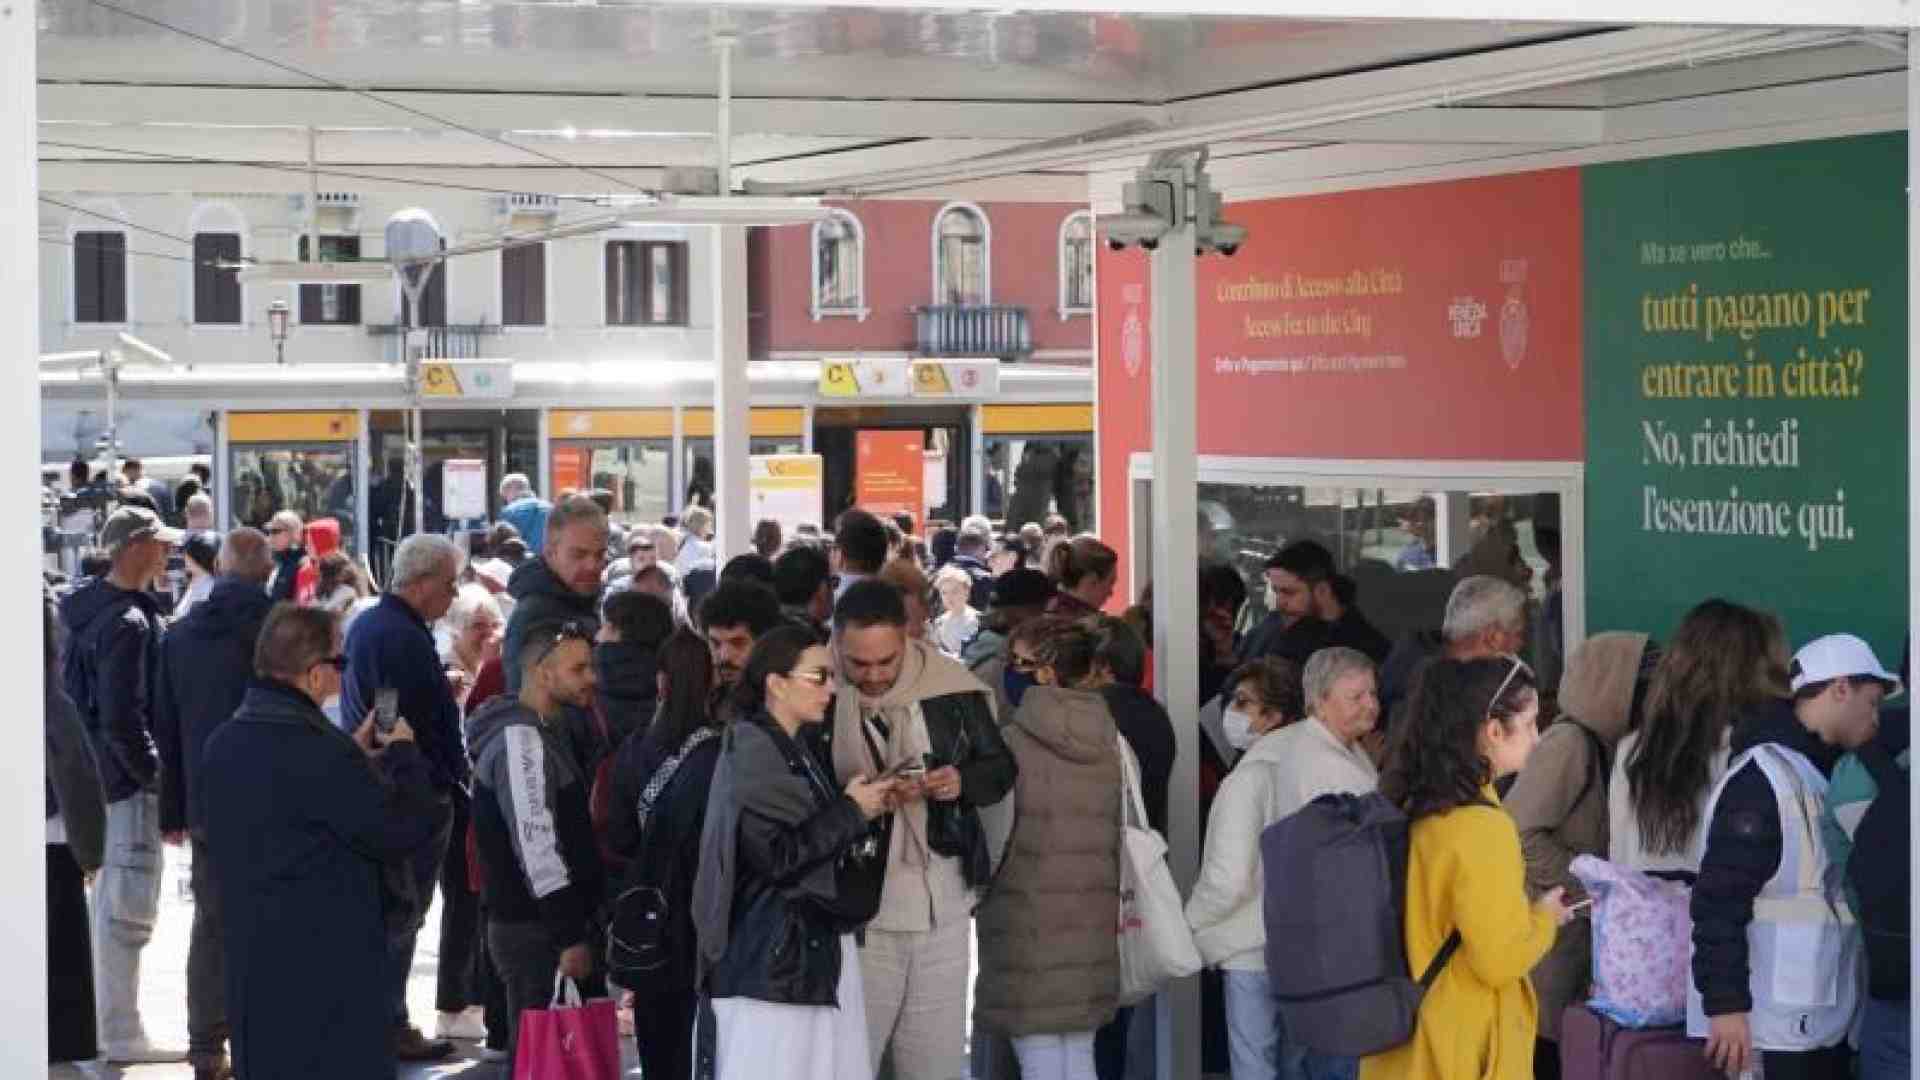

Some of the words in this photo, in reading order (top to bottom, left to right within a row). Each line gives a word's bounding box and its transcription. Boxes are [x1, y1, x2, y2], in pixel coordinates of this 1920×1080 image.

[1690, 242, 1726, 262] vero
[1642, 281, 1698, 332] tutti
[1704, 293, 1811, 342] pagano
[1816, 289, 1871, 338] per
[1642, 362, 1740, 399] entrare
[1745, 349, 1776, 397] in
[1782, 347, 1864, 397] città?
[1642, 419, 1687, 470] No,
[1691, 417, 1799, 466] richiedi
[1642, 484, 1793, 537] l'esenzione
[1797, 488, 1854, 551] qui.
